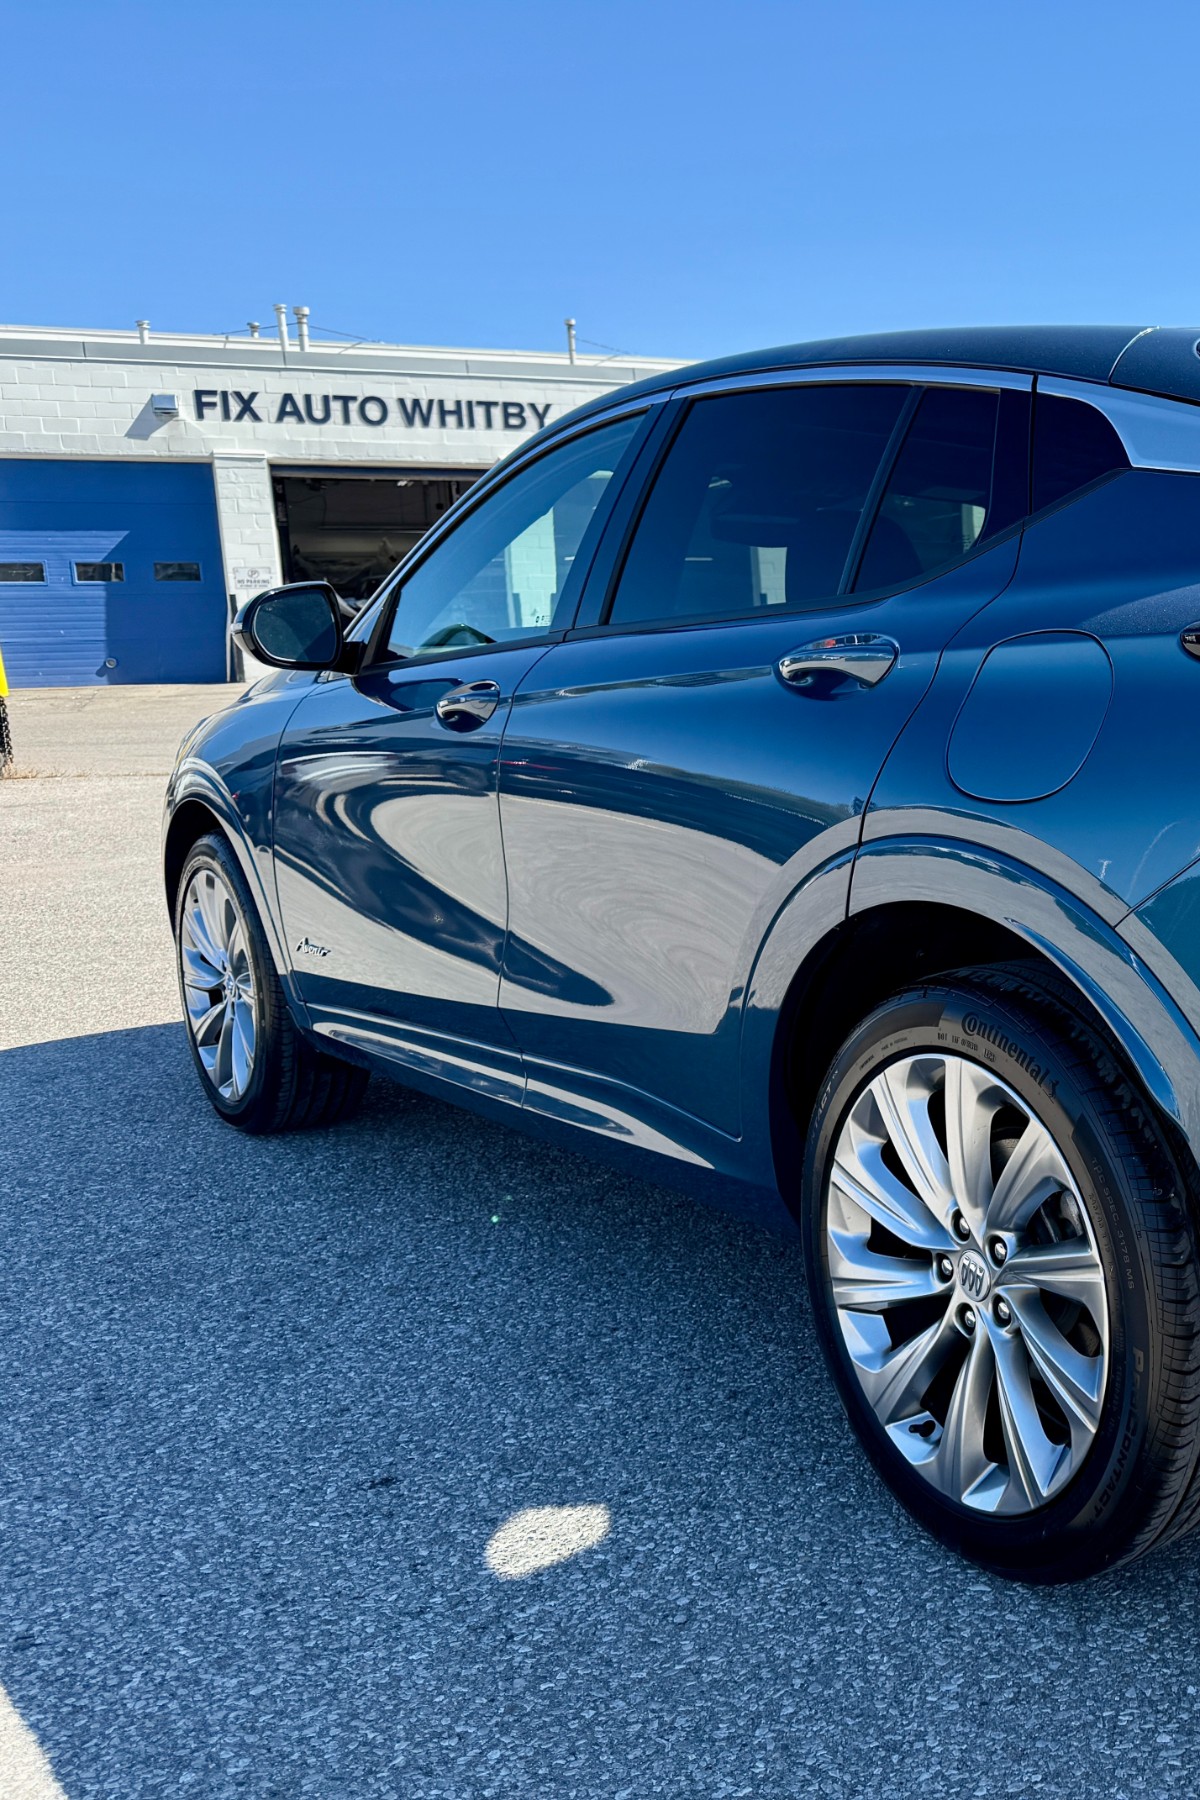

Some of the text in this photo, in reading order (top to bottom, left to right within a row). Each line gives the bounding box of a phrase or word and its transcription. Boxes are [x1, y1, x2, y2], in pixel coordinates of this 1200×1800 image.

[194, 389, 552, 430] FIX AUTO WHITBY
[961, 1011, 1050, 1088] Continental
